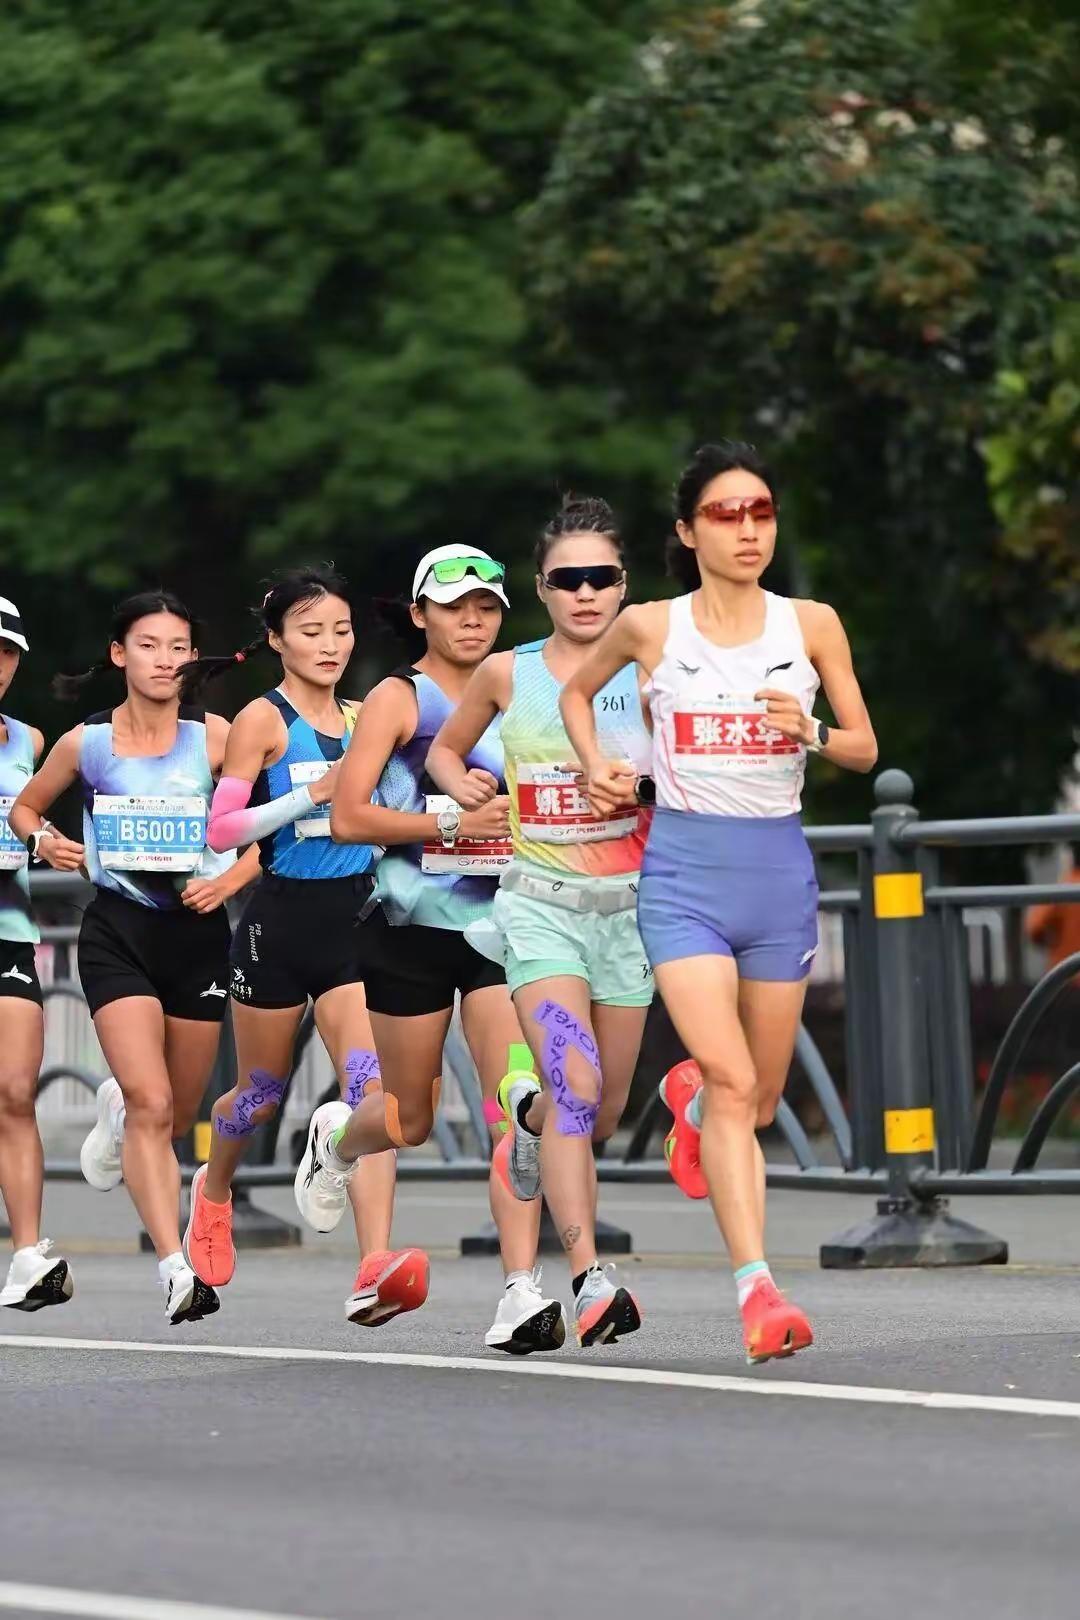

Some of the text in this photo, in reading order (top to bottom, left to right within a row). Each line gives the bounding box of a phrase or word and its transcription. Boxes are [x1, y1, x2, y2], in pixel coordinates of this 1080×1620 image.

[120, 819, 202, 842] B50013
[254, 922, 262, 937] PB
[248, 924, 259, 962] RUNNER
